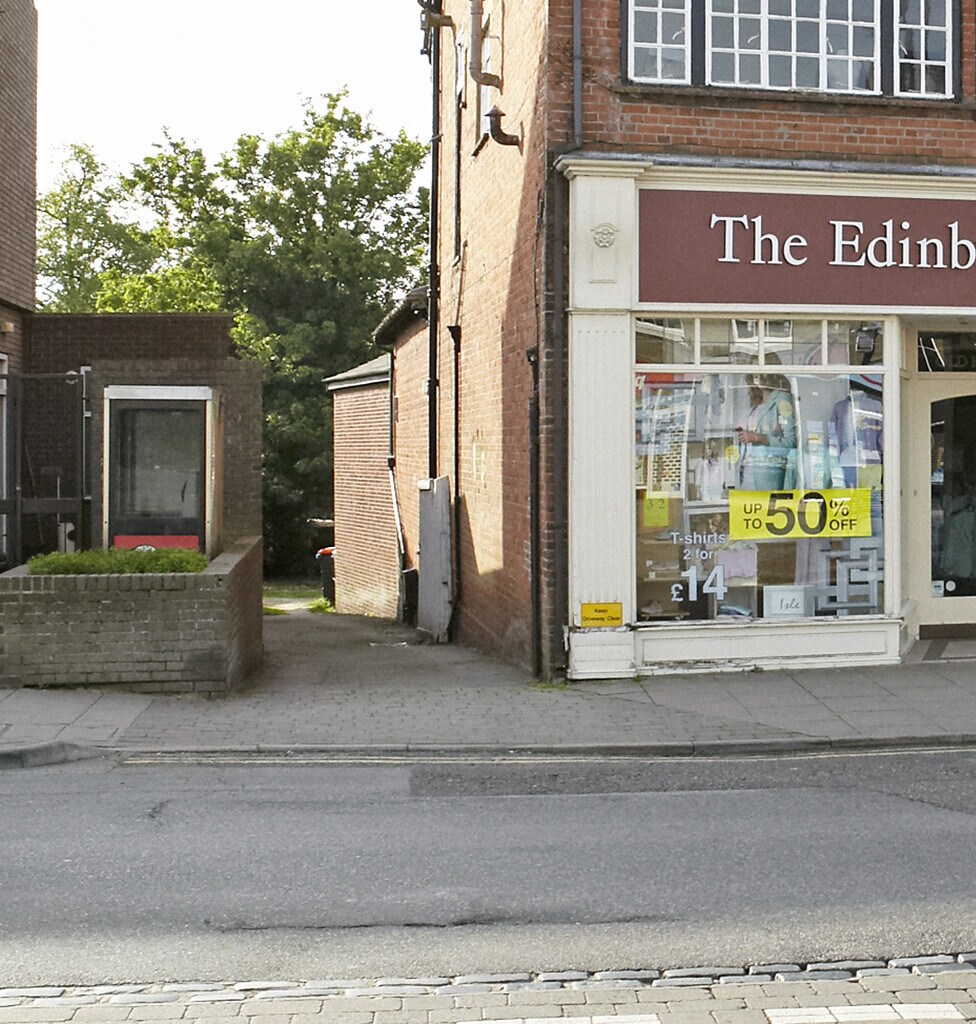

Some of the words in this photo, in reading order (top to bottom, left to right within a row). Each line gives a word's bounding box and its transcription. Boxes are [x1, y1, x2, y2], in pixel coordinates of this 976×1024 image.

[711, 213, 808, 265] The
[743, 504, 763, 514] UP
[743, 518, 762, 529] TO
[829, 519, 857, 530] OFF
[671, 532, 726, 544] T-shirts
[683, 549, 692, 560] 2
[695, 548, 714, 559] for
[671, 565, 728, 602] £14
